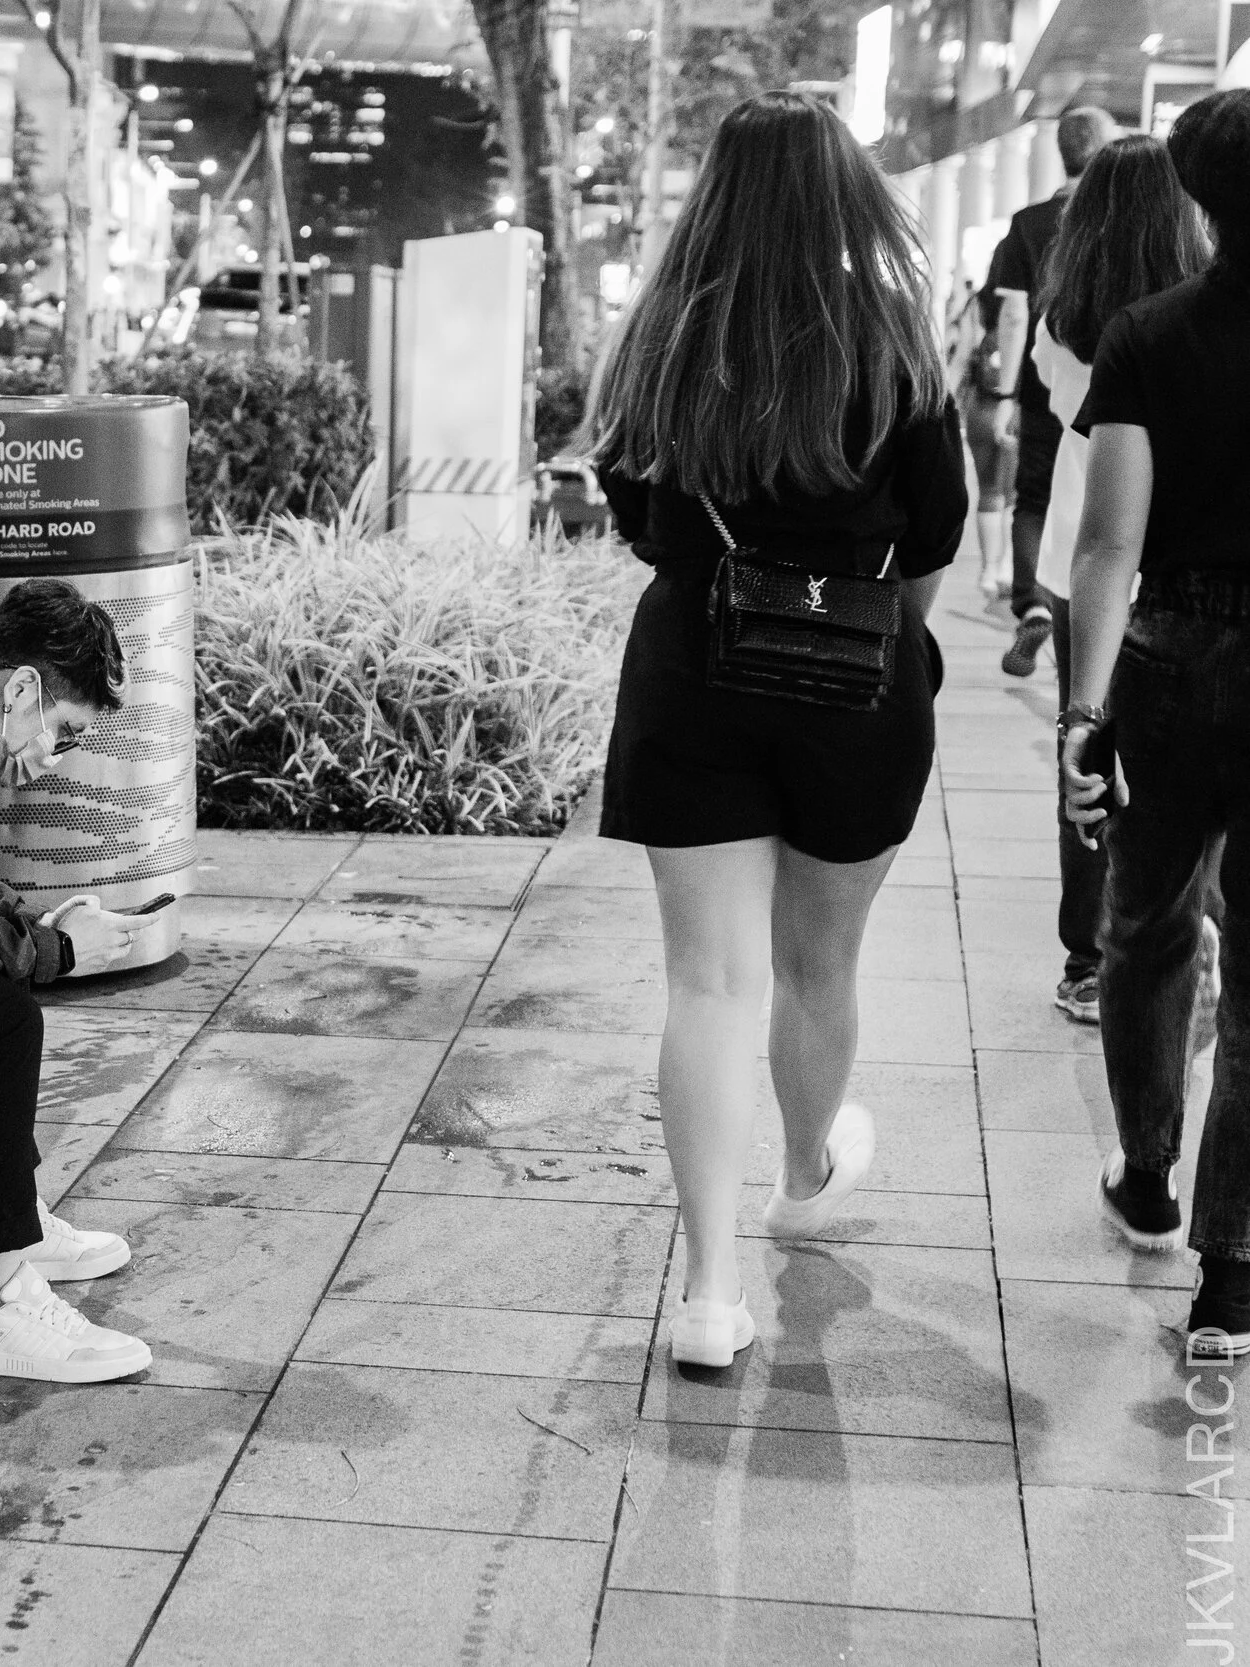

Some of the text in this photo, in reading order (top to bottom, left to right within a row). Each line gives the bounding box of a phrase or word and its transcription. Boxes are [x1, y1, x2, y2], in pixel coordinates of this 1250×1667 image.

[5, 489, 29, 500] only
[30, 489, 41, 498] at
[28, 499, 72, 510] Smoking
[73, 498, 100, 508] Areas
[48, 521, 96, 537] ROAD
[0, 542, 18, 550] code
[0, 550, 30, 559] Smoking
[31, 549, 52, 557] Areas
